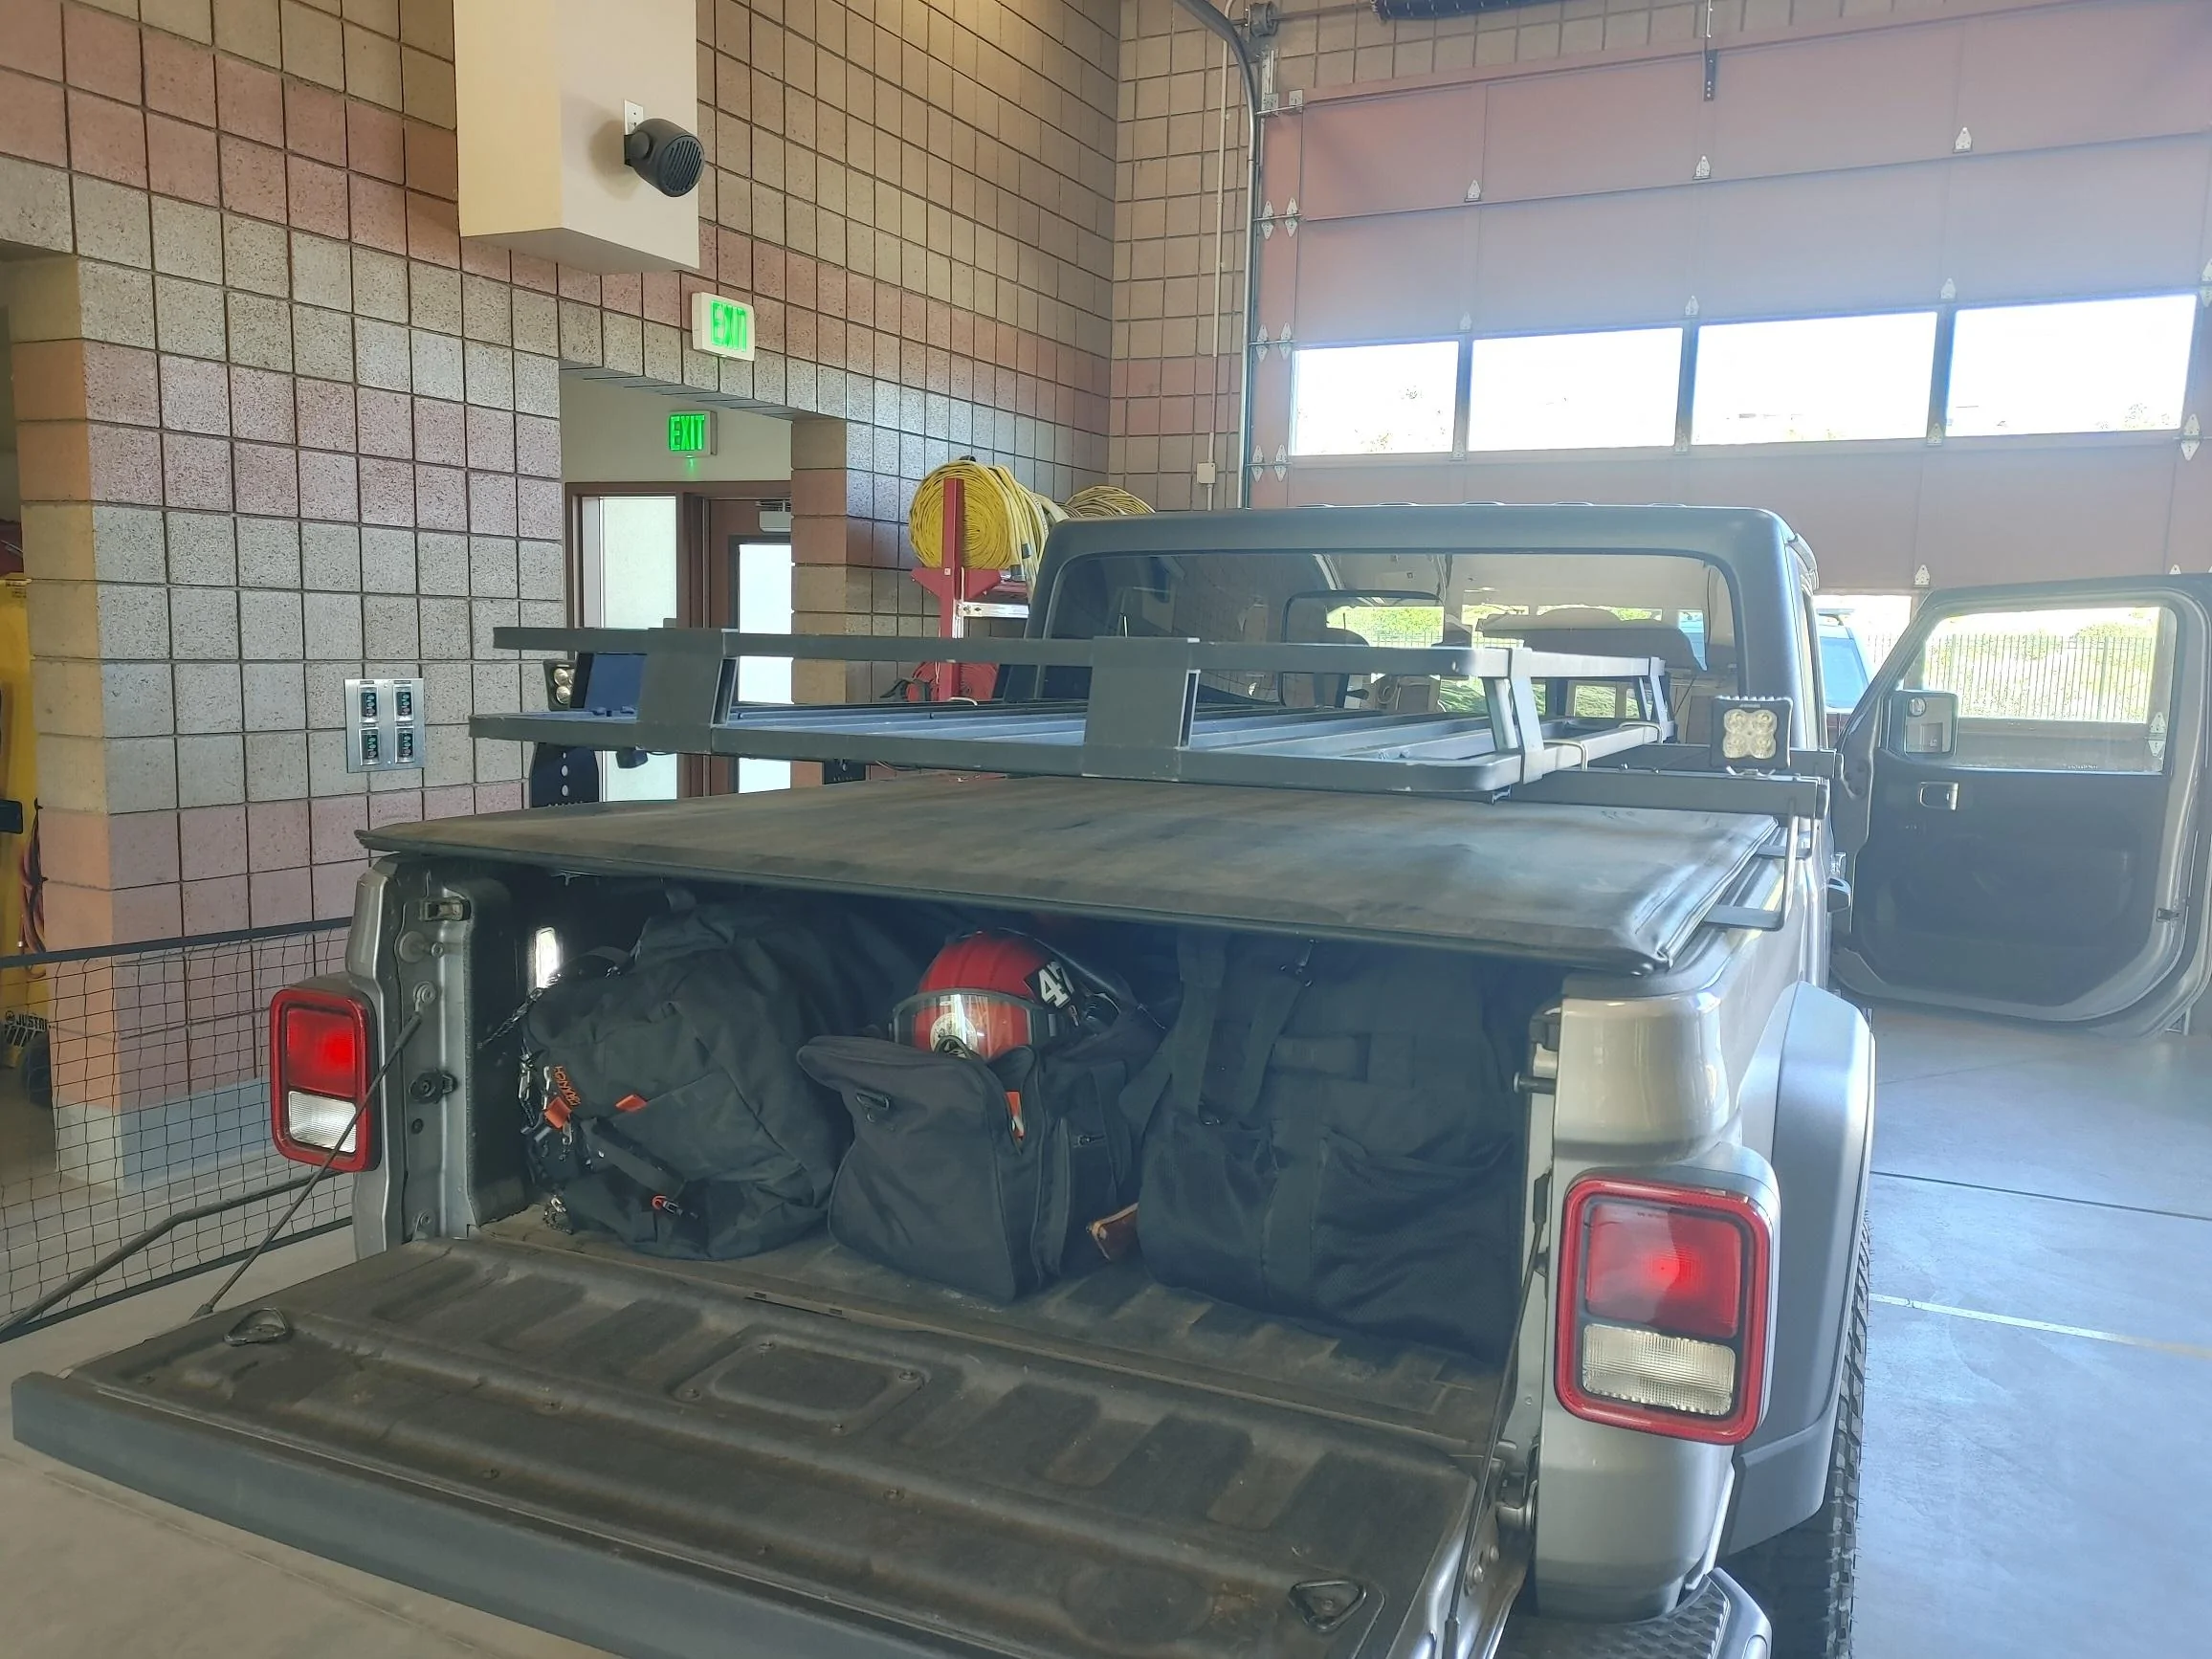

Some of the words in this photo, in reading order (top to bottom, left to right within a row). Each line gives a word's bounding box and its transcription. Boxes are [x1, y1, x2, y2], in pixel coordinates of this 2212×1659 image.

[711, 299, 747, 352] EXIT
[670, 414, 705, 451] EXIT
[1038, 961, 1075, 1009] 47
